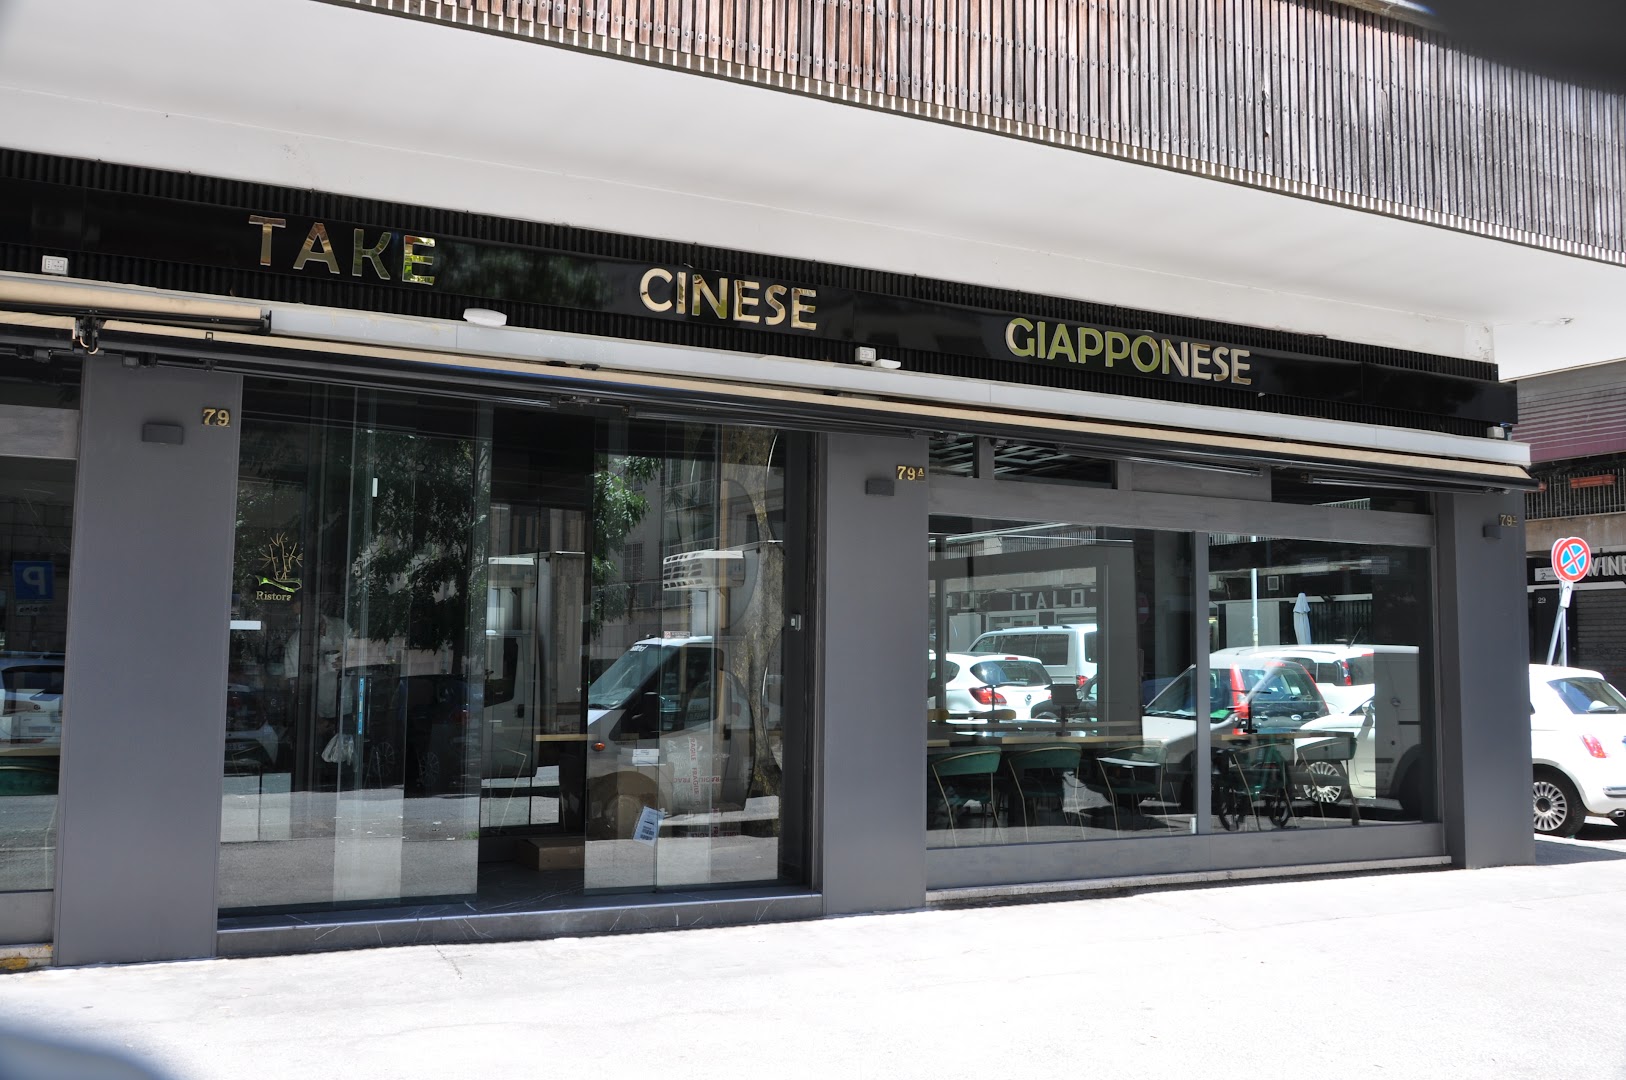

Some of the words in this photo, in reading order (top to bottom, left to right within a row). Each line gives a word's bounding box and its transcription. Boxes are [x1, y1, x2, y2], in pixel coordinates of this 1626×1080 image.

[249, 214, 436, 286] TAKE
[640, 267, 817, 331] CINESE
[1005, 317, 1252, 385] GIAPPONESE
[203, 408, 230, 427] 79
[897, 465, 925, 480] 79A
[1011, 588, 1085, 611] ITALO
